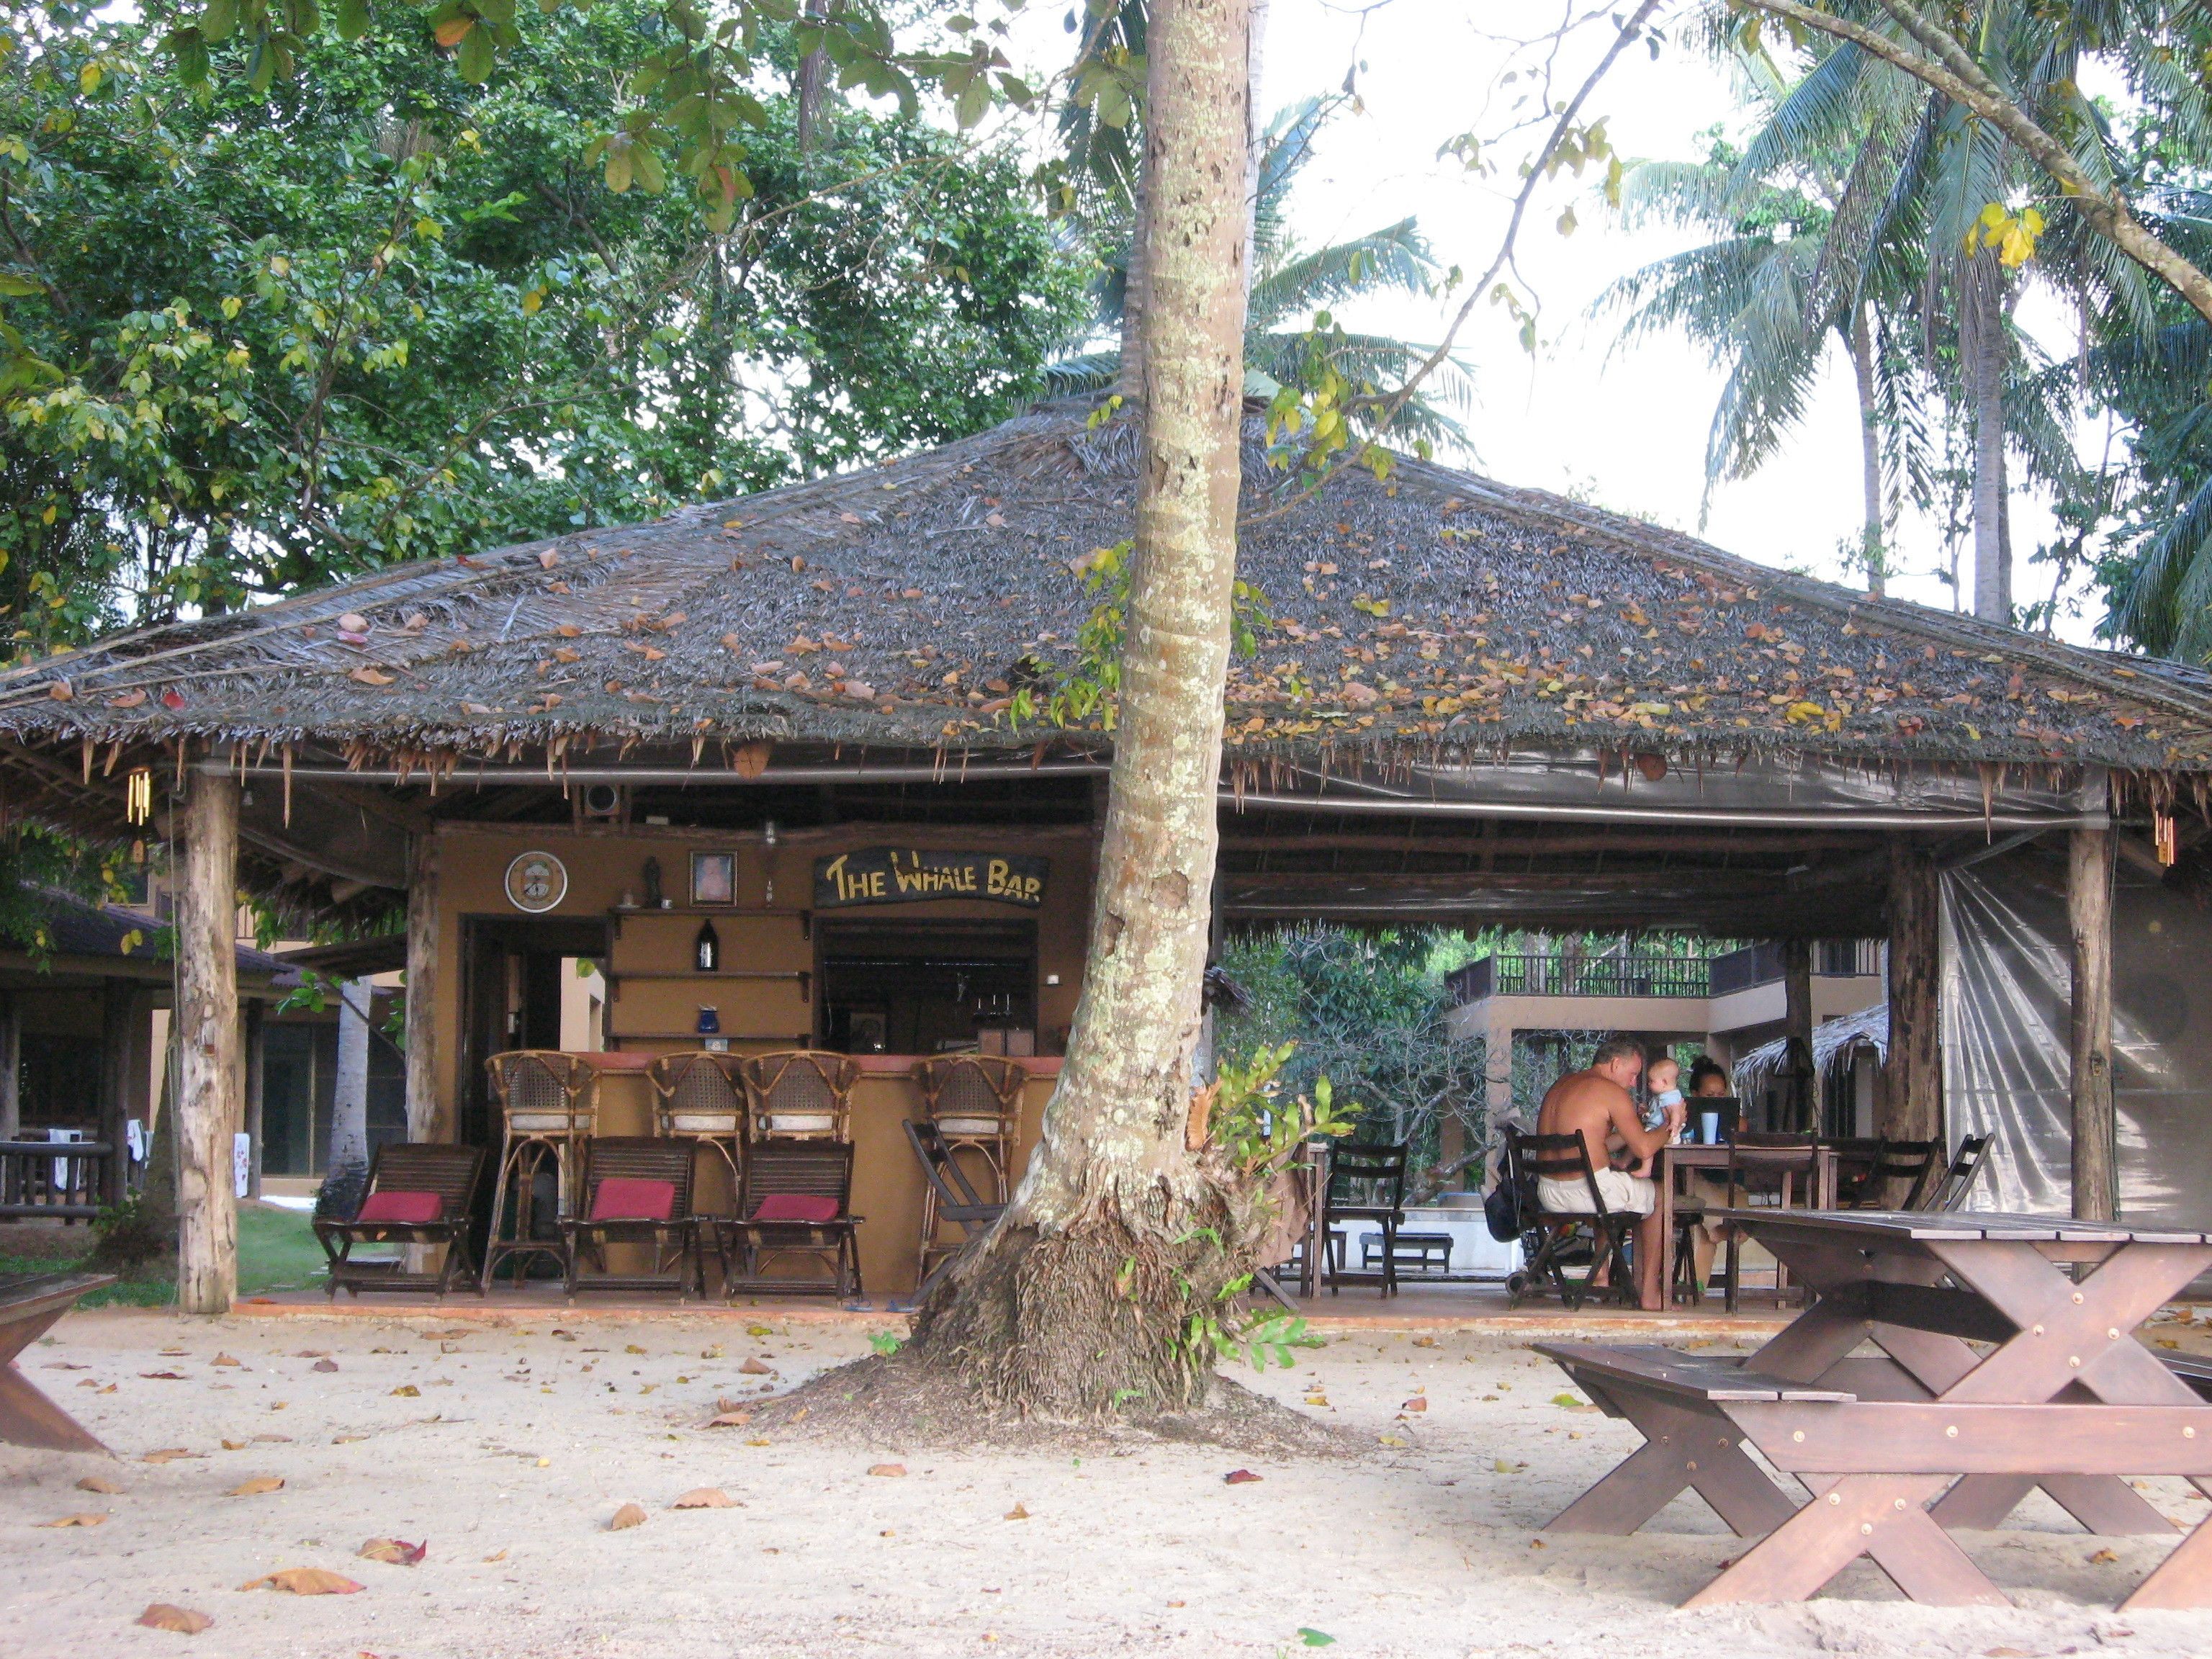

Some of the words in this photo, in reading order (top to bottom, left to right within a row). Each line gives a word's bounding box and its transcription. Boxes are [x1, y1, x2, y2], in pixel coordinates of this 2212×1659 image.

[826, 855, 886, 900] THE
[891, 850, 977, 893] WHALE
[987, 859, 1040, 902] BAR
